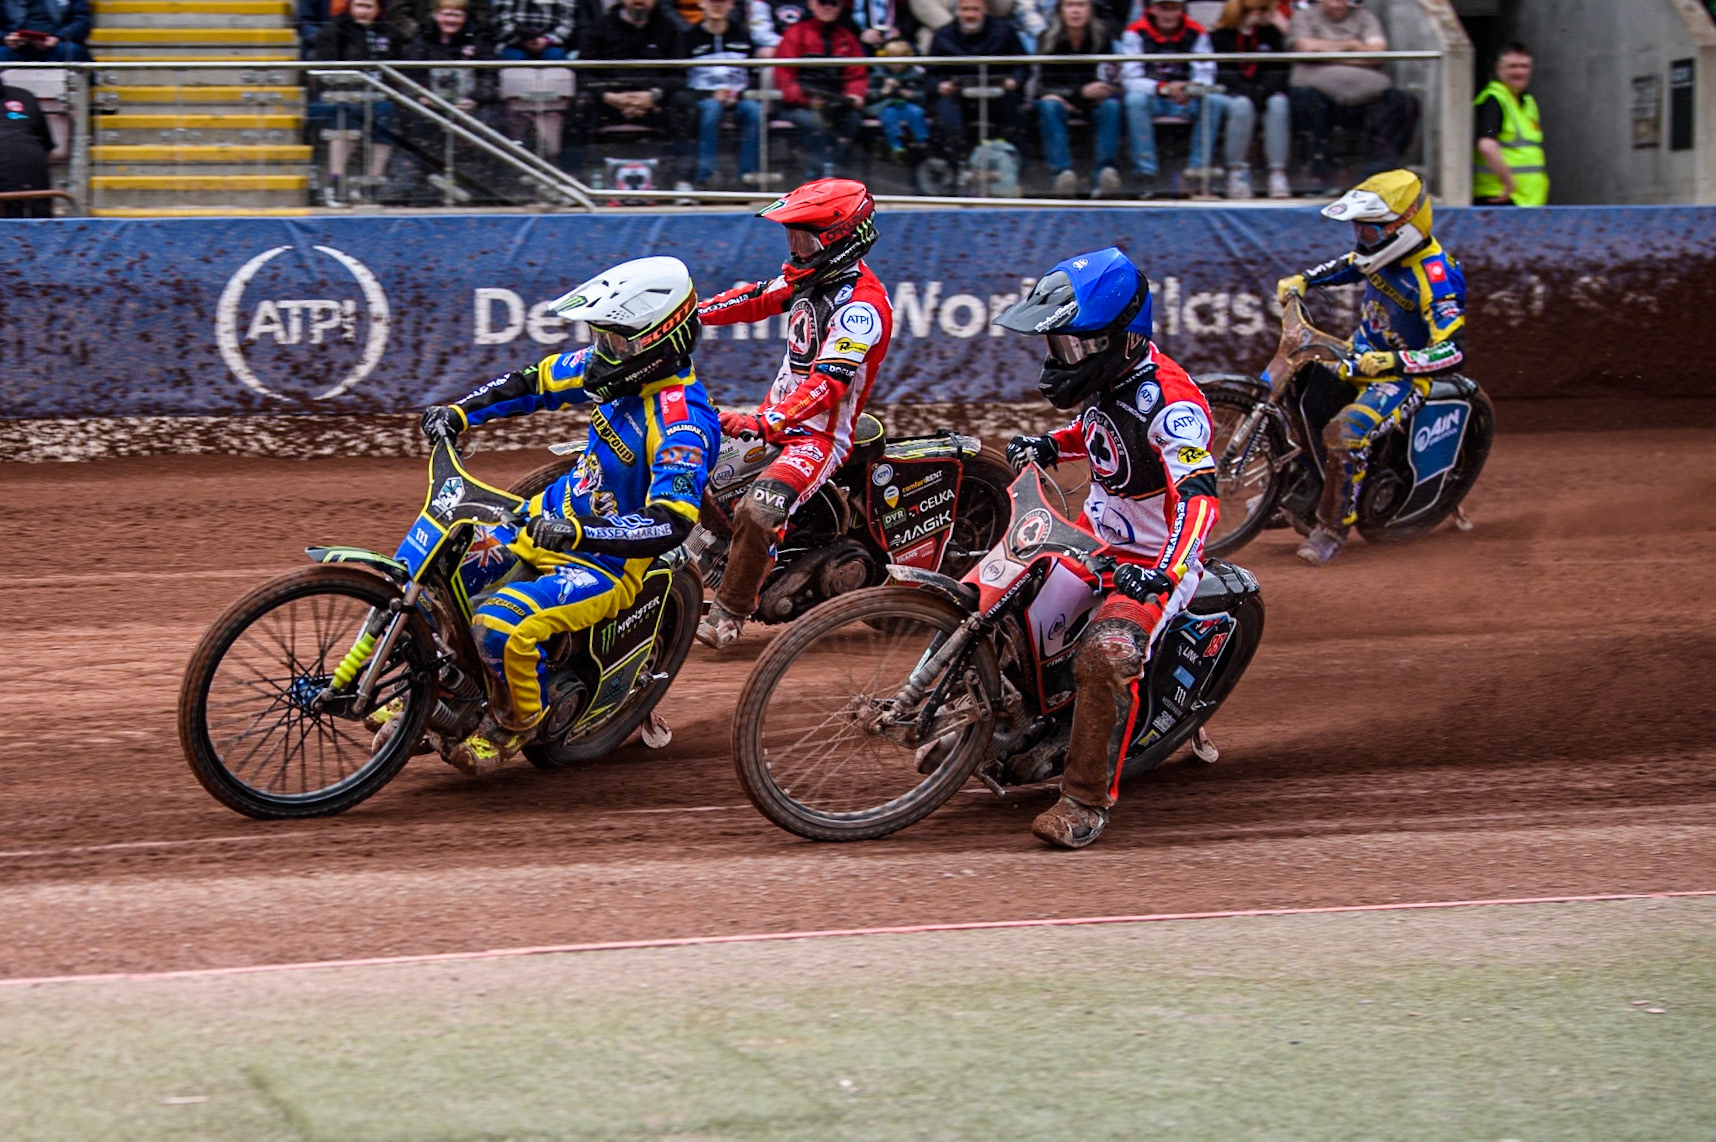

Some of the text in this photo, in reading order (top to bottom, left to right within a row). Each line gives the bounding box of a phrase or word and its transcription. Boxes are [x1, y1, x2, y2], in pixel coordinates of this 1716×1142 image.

[641, 302, 691, 347] SCOTT
[846, 314, 869, 326] ATPI
[754, 488, 786, 509] DVR
[919, 489, 955, 512] CELKA
[885, 510, 904, 524] DVR
[584, 523, 672, 540] WESSEX MARINE
[617, 595, 661, 634] MONSTER
[1183, 646, 1199, 664] LINK
